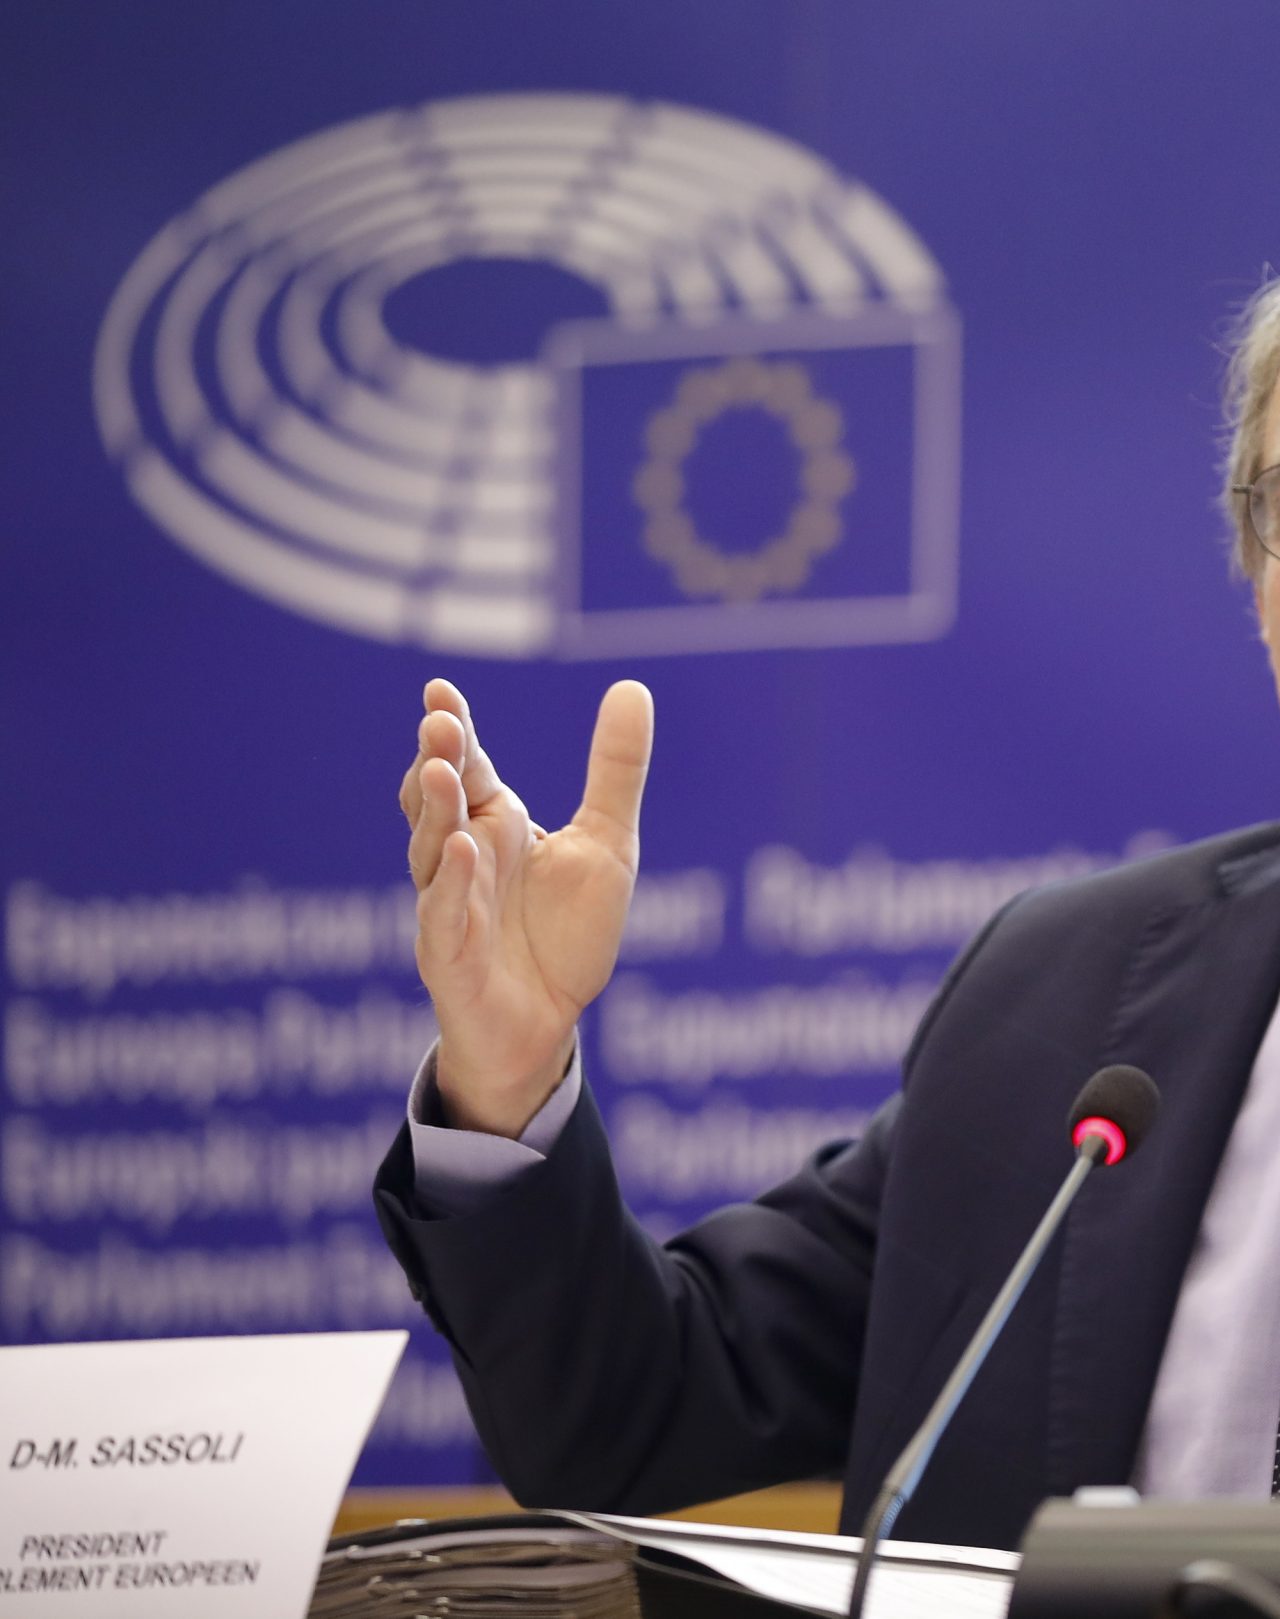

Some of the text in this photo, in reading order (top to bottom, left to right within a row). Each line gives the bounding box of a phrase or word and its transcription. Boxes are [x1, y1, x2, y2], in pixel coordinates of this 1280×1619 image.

[9, 1432, 245, 1470] D-M. SASSOLI
[19, 1530, 168, 1561] PRESIDENT
[113, 1558, 261, 1591] EUROPEEN
